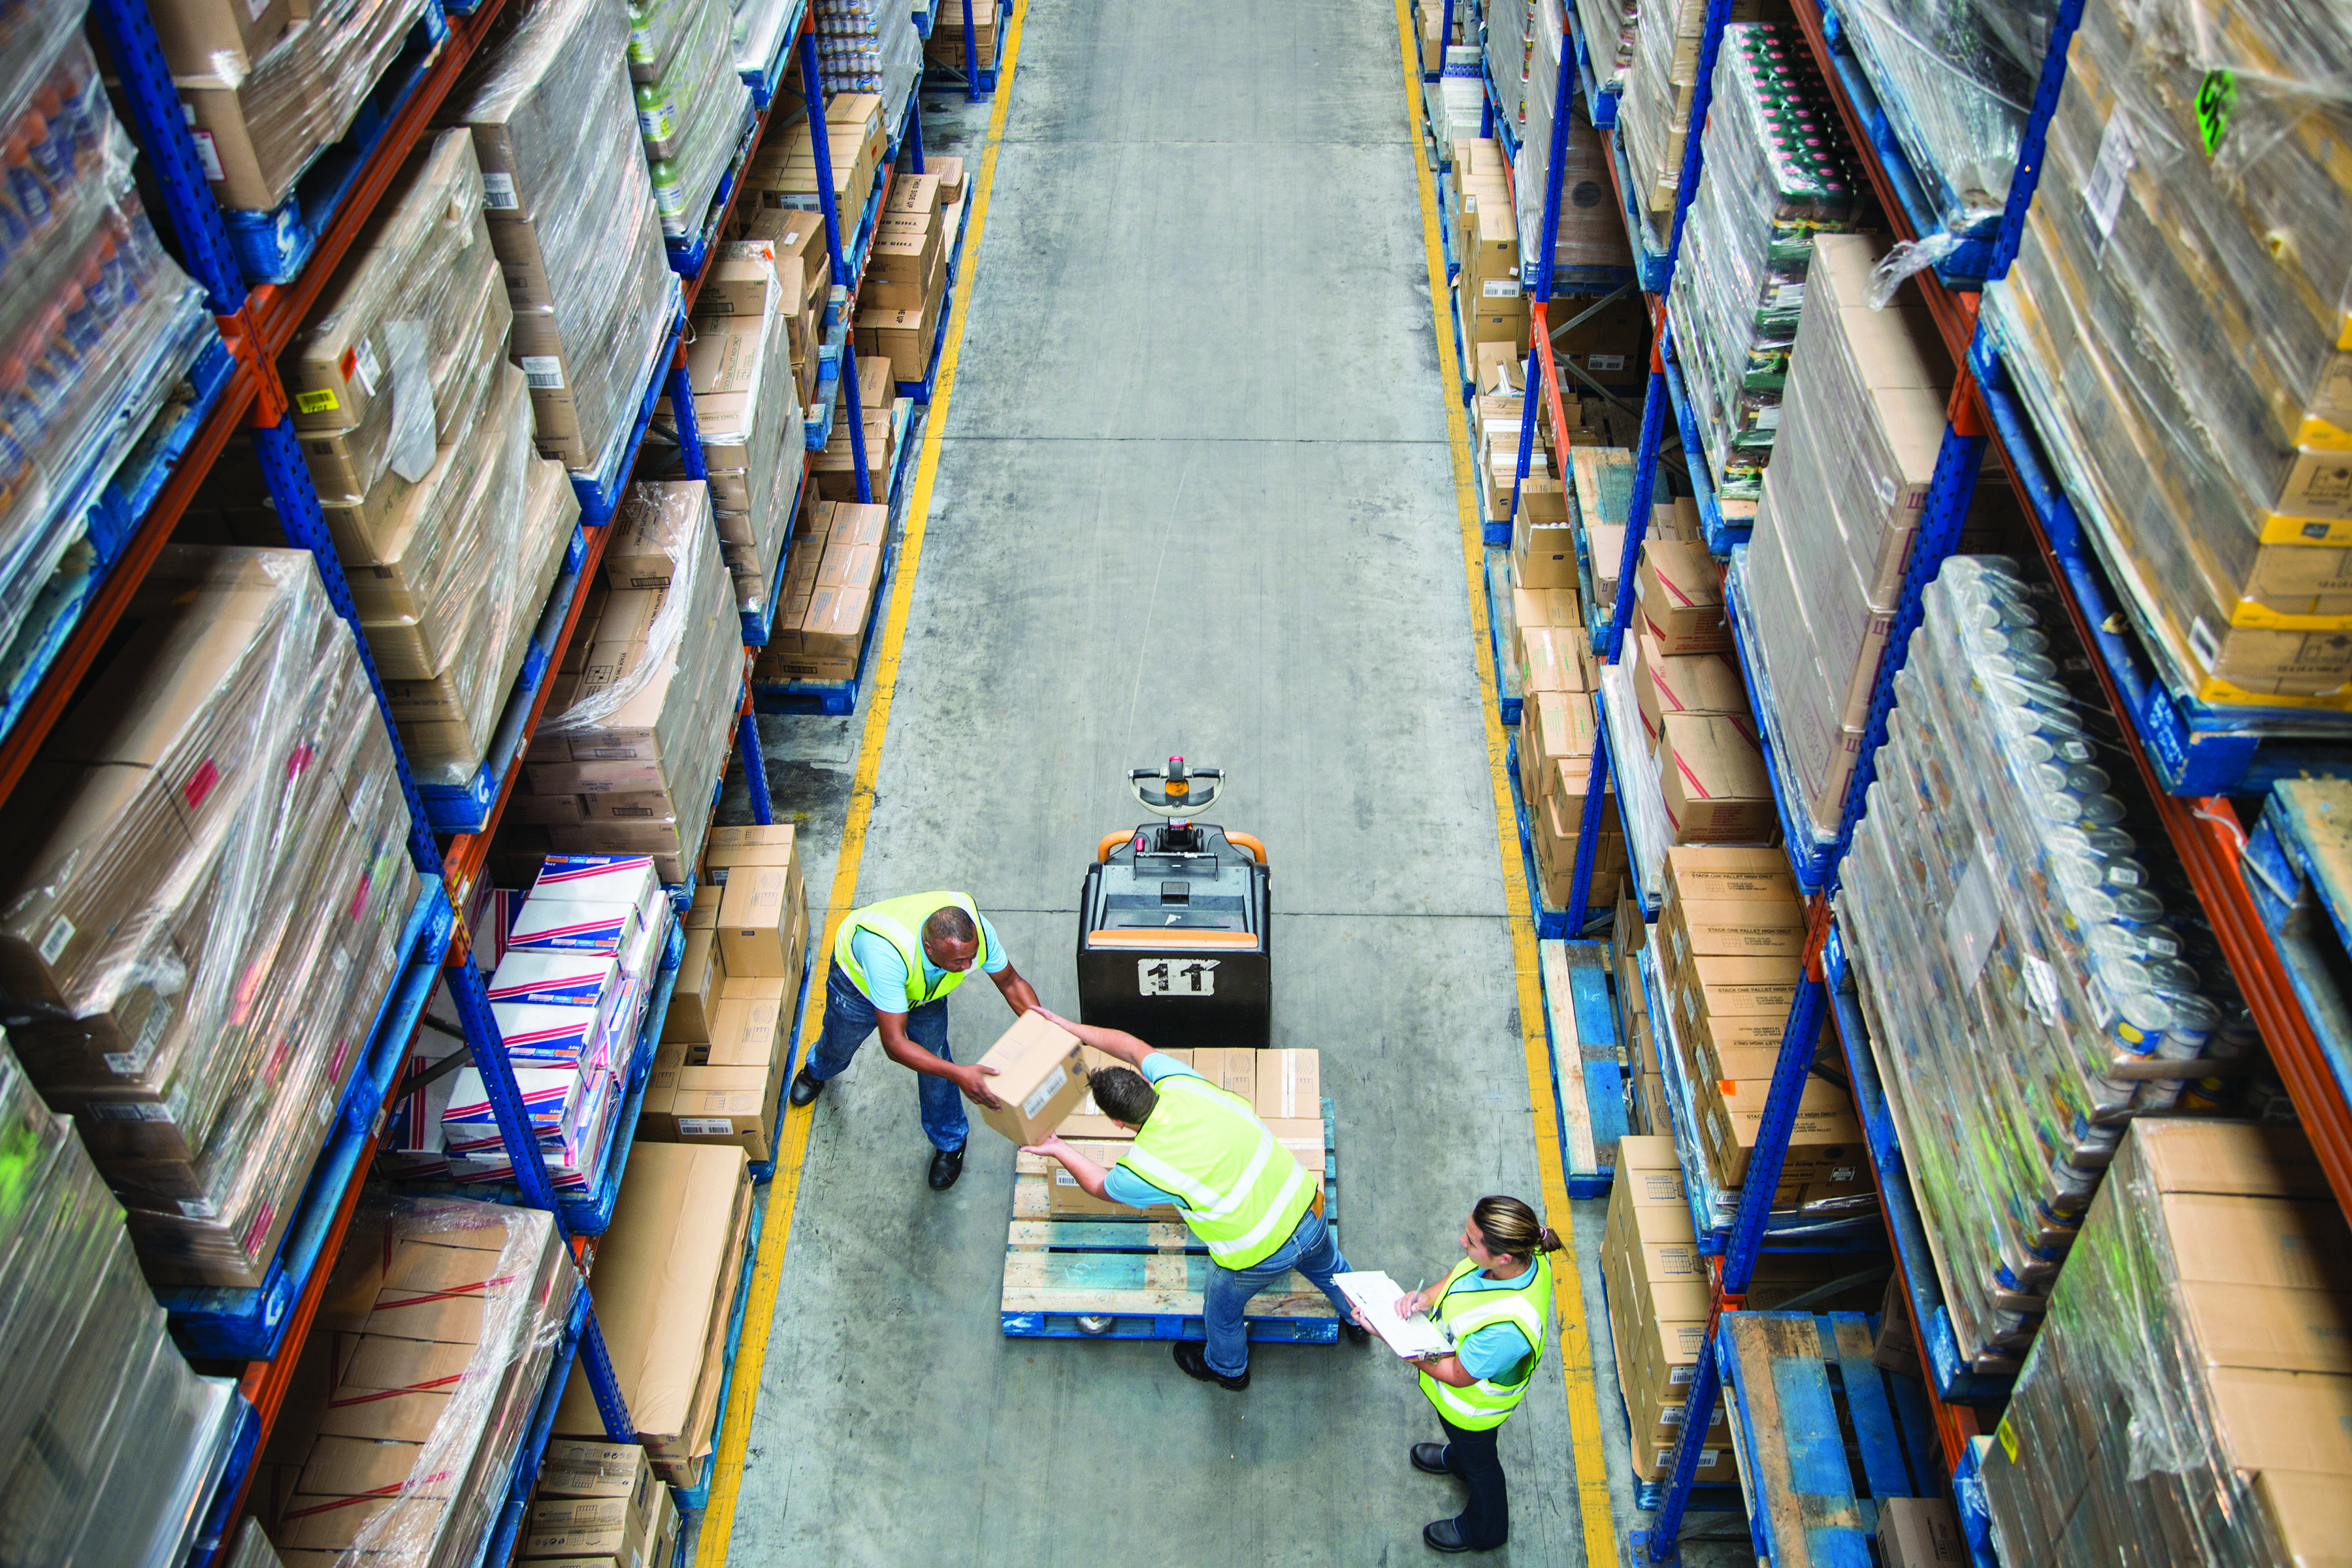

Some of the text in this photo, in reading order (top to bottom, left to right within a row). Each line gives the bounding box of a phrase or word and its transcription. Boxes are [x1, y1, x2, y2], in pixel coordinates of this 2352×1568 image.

[912, 178, 922, 189] THIS
[908, 189, 918, 201] SIDE
[654, 594, 662, 610] PALLETS
[1147, 963, 1202, 992] 11
